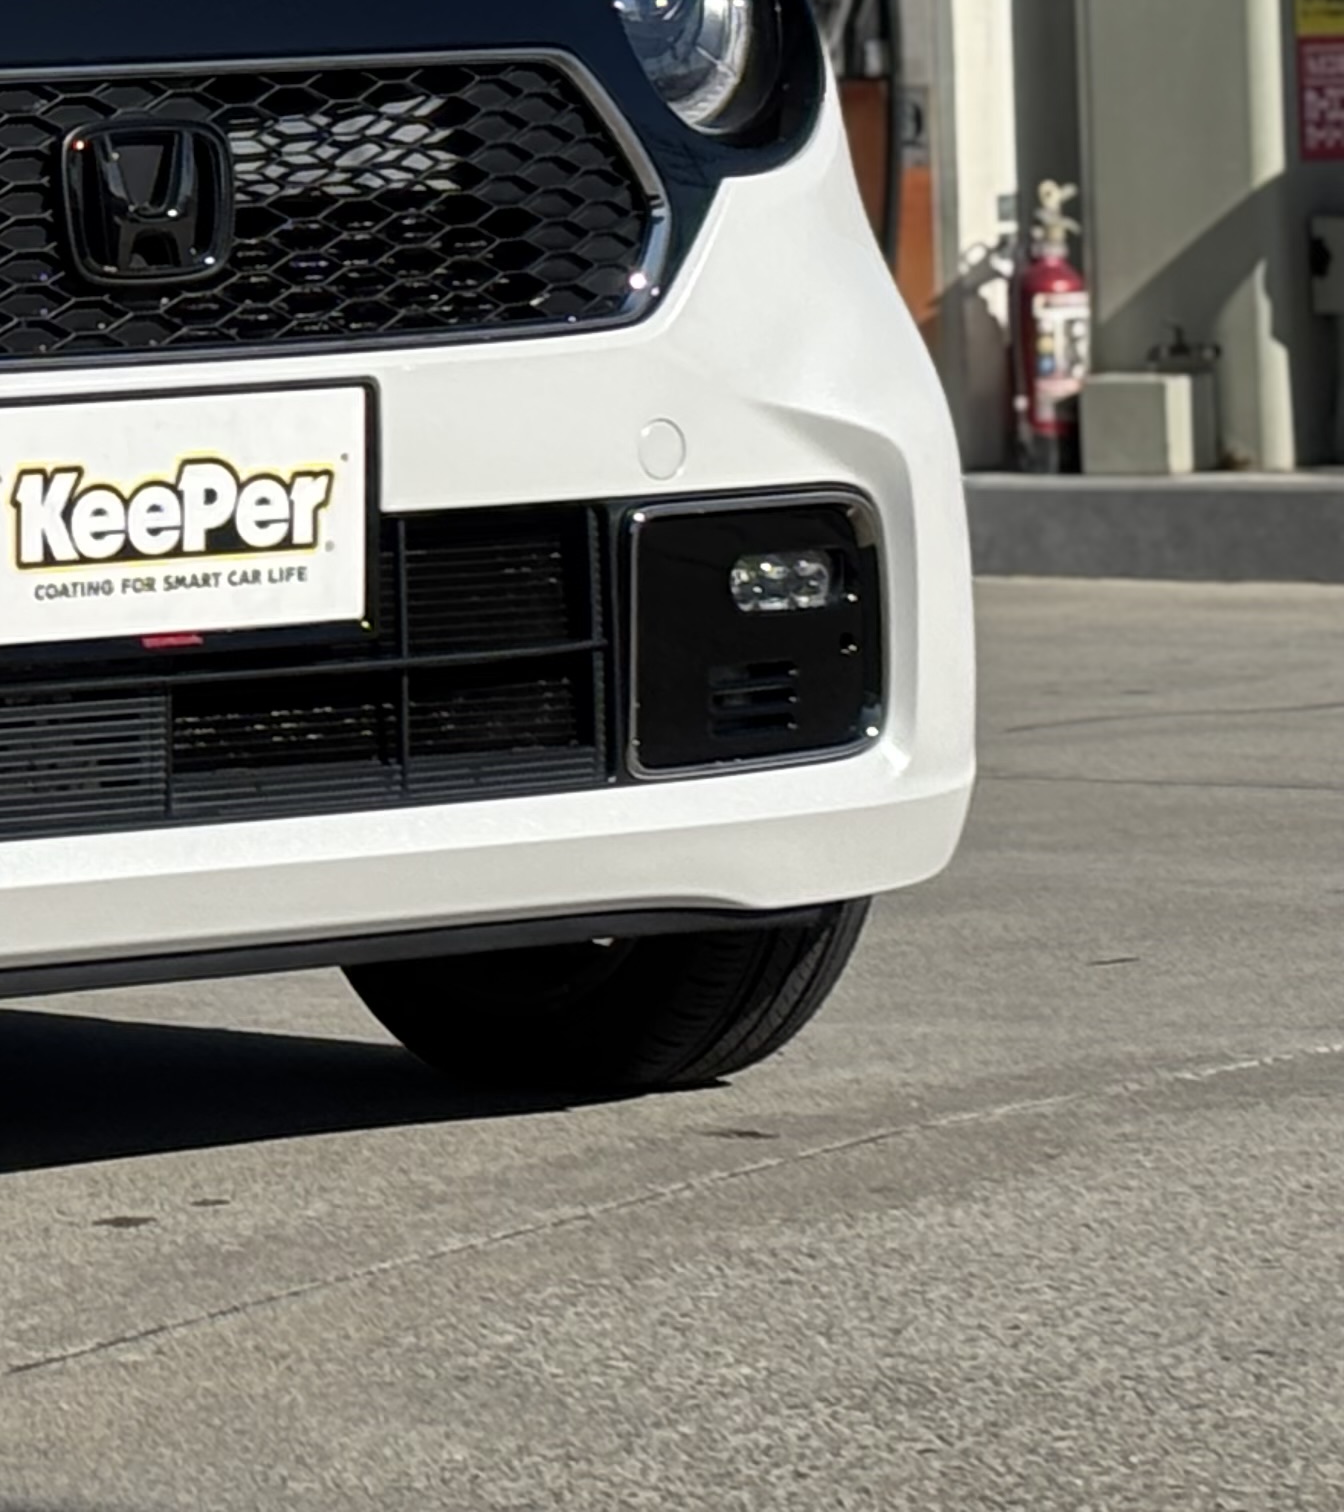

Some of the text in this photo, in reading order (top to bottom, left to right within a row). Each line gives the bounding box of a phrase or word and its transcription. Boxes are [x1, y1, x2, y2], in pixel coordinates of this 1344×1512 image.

[11, 457, 332, 569] KeePer
[34, 565, 307, 602] COATING FOR SMART CAR LIFE
